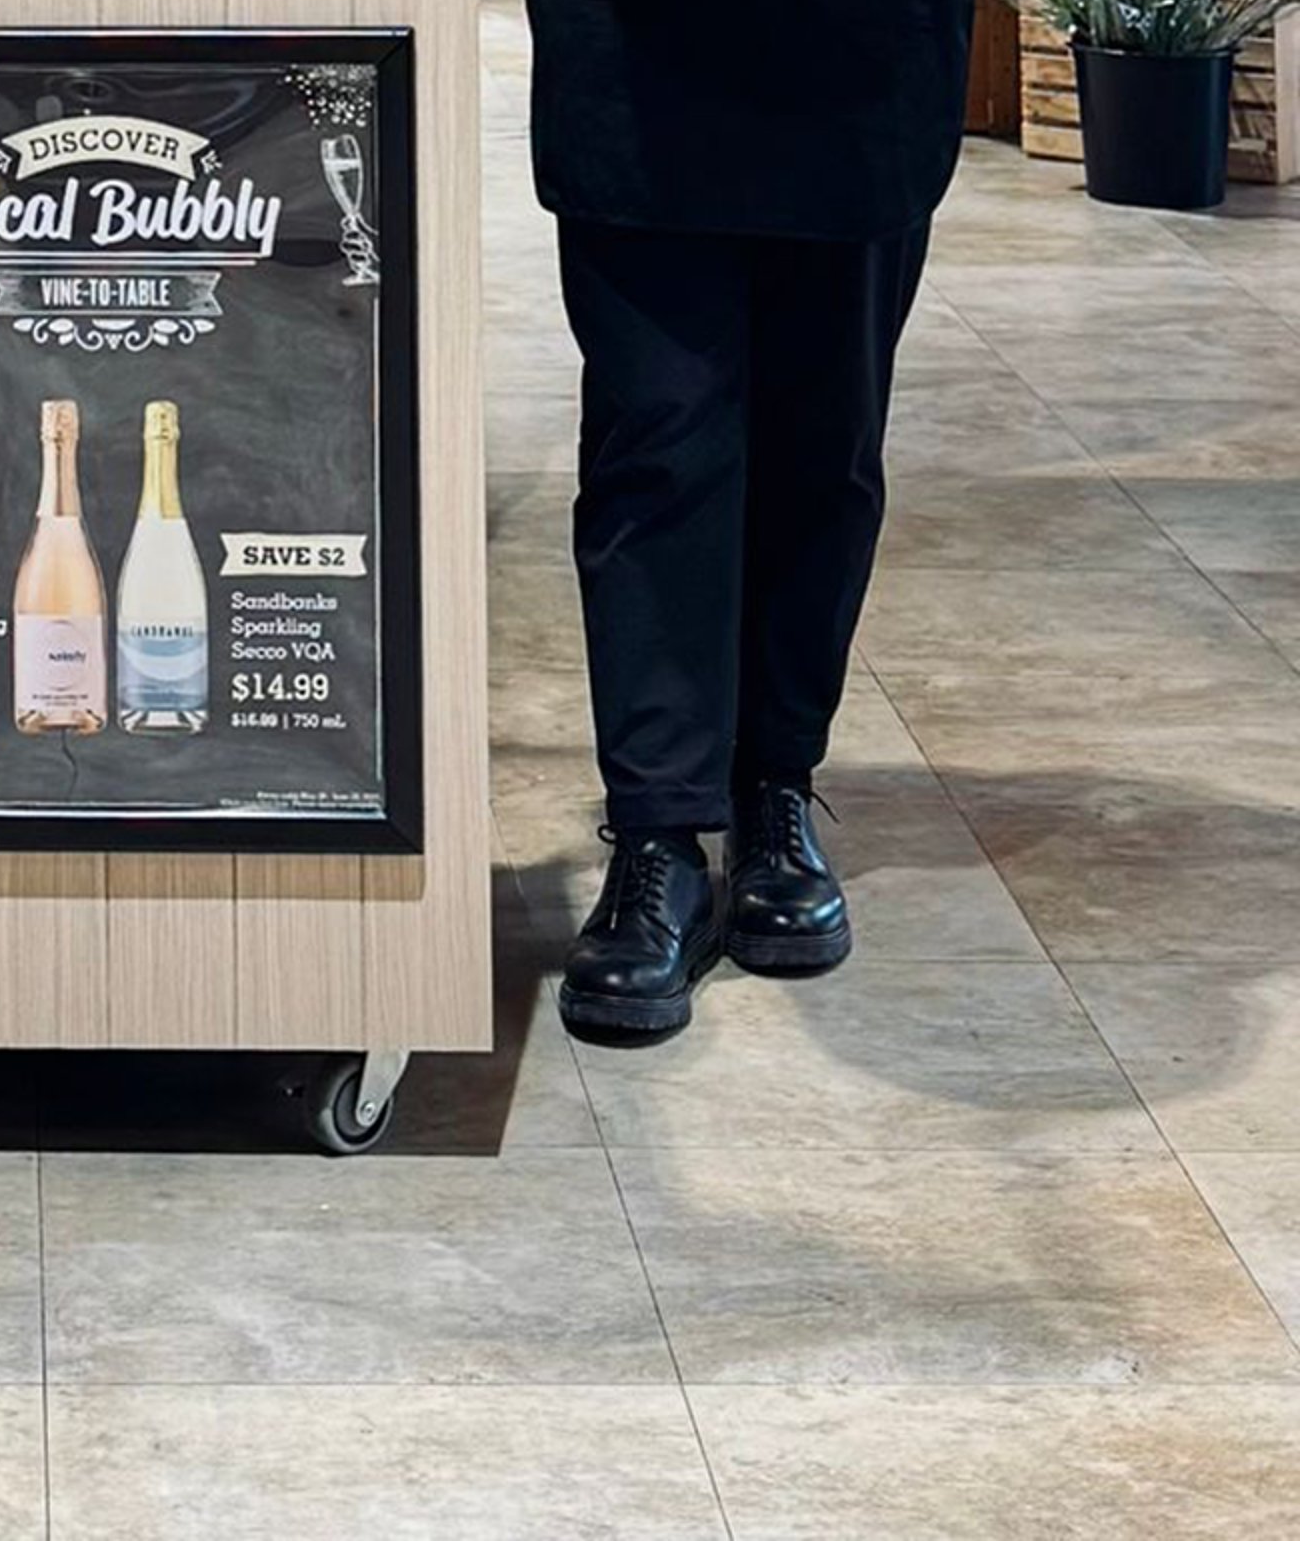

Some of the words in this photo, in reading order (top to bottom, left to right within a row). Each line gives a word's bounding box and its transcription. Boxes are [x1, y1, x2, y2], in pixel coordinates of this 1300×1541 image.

[28, 127, 181, 161] DISCOVER
[89, 177, 282, 259] Bubbly
[41, 277, 171, 307] VINE-TO-TABLE
[242, 546, 312, 566] SAVE
[317, 547, 346, 567] $2
[230, 591, 339, 611] Sandbanks
[230, 616, 323, 639] Sparkling
[230, 642, 288, 661] Secco
[290, 642, 337, 662] VQA
[230, 672, 331, 703] $14.99
[292, 713, 320, 729] 750
